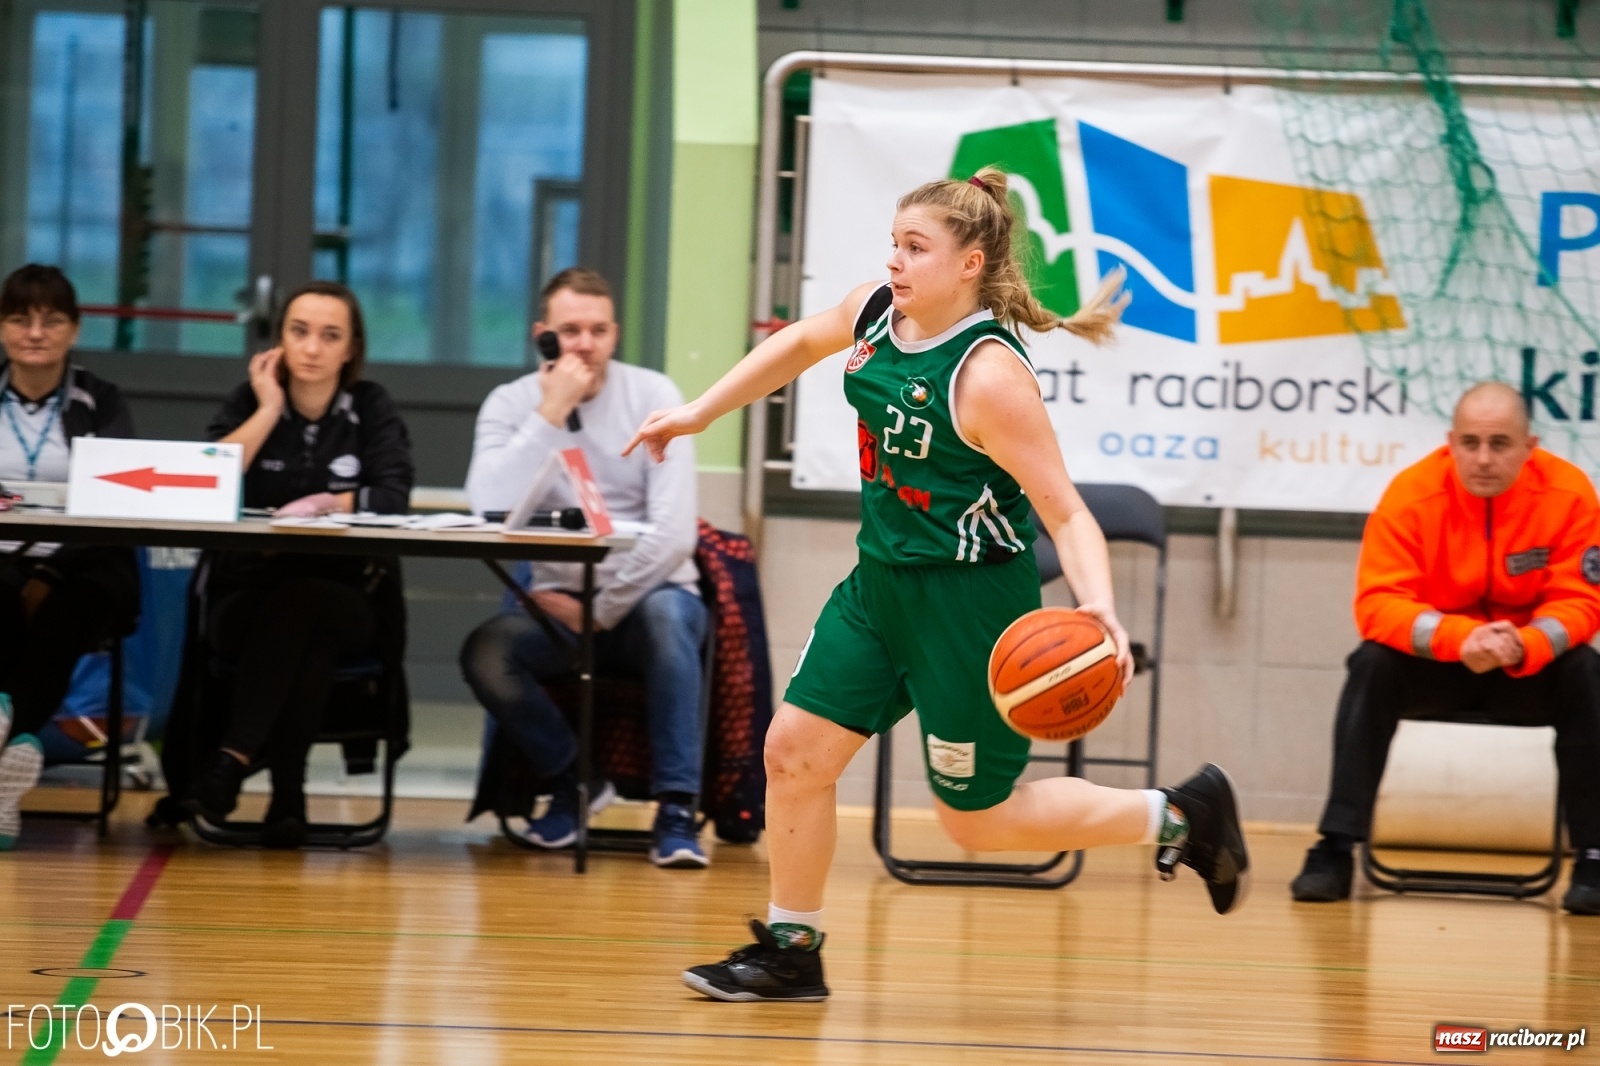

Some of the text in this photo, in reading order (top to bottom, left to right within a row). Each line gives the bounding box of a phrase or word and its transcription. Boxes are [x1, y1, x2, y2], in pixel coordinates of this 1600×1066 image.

[1127, 361, 1408, 416] raciborski
[883, 404, 933, 460] 23
[1099, 429, 1405, 467] oaza kultur
